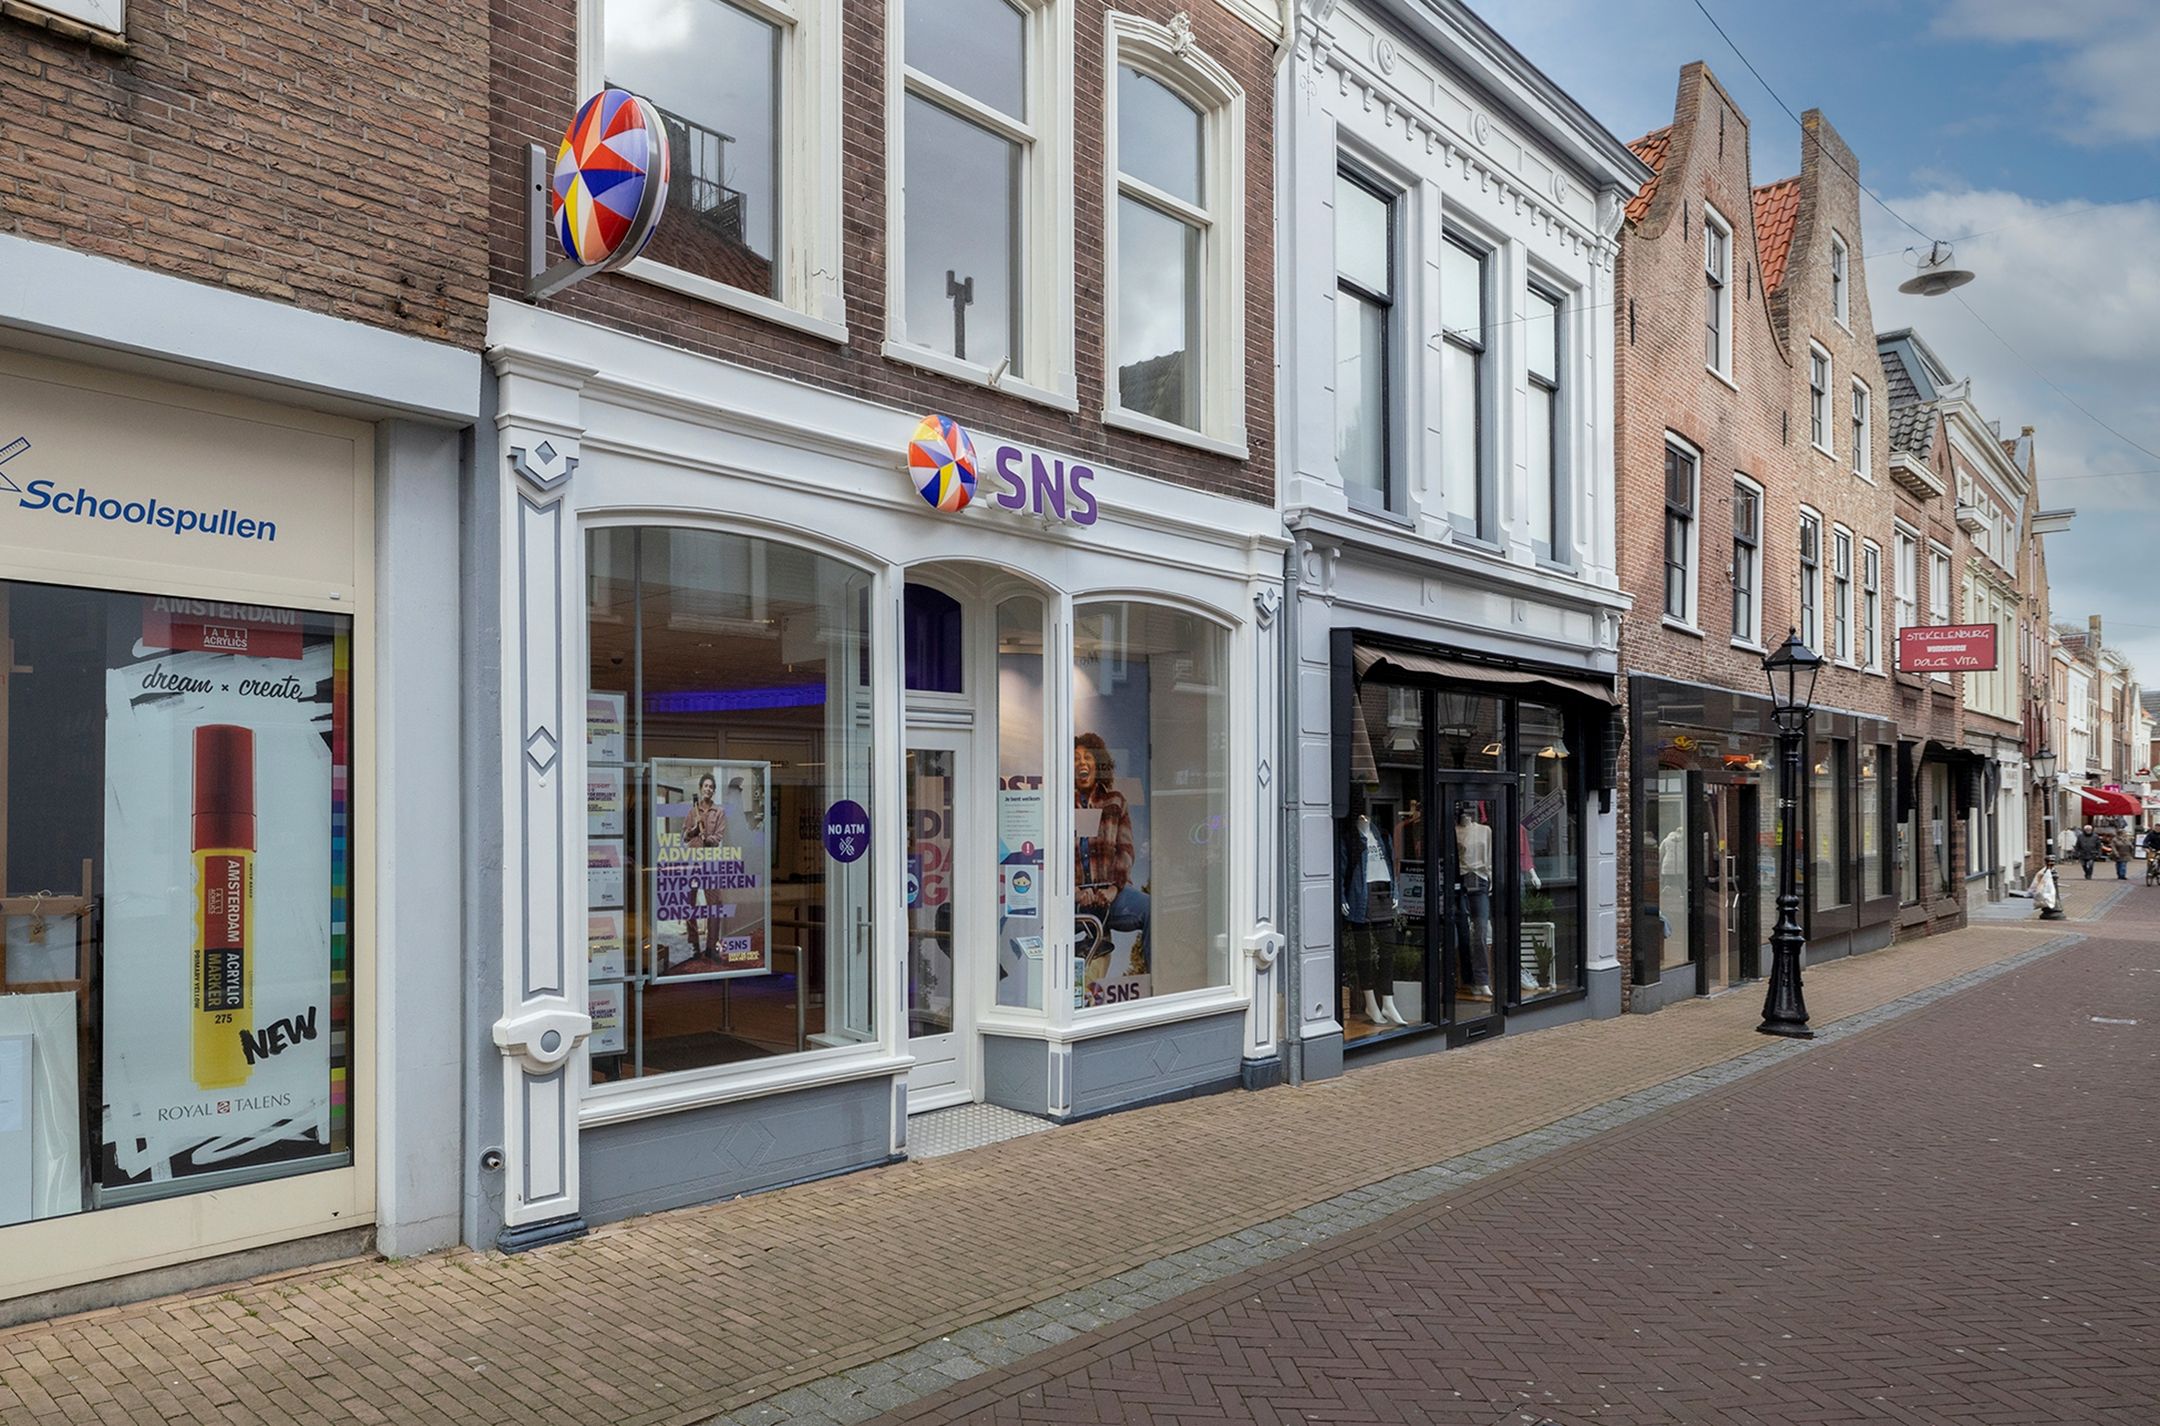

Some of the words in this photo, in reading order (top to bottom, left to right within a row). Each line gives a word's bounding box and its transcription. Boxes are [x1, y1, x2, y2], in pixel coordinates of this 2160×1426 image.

[996, 446, 1098, 525] SNS
[19, 479, 278, 542] Schoolspullen
[204, 636, 248, 648] ACRYLICS
[1906, 630, 1990, 641] STEKELENBURG
[1954, 656, 1979, 666] VITA
[142, 664, 213, 693] dream
[239, 675, 303, 700] create
[828, 824, 842, 835] NO
[844, 823, 865, 835] ATM
[658, 832, 681, 847] WE
[658, 847, 742, 861] ADVISEREN
[691, 861, 745, 876] ALLEEN
[657, 875, 756, 892] HYPOTHEKEN
[227, 860, 240, 943] AMSTERDAM
[657, 892, 690, 906] VAN
[729, 940, 748, 951] SNS
[208, 953, 222, 1006] MARKER
[227, 953, 240, 1005] ACRYLIC
[1106, 982, 1141, 1004] SNS
[215, 1014, 233, 1024] 275
[239, 1006, 317, 1065] NEW
[158, 1103, 213, 1121] ROYAL
[235, 1093, 292, 1112] TALENS
